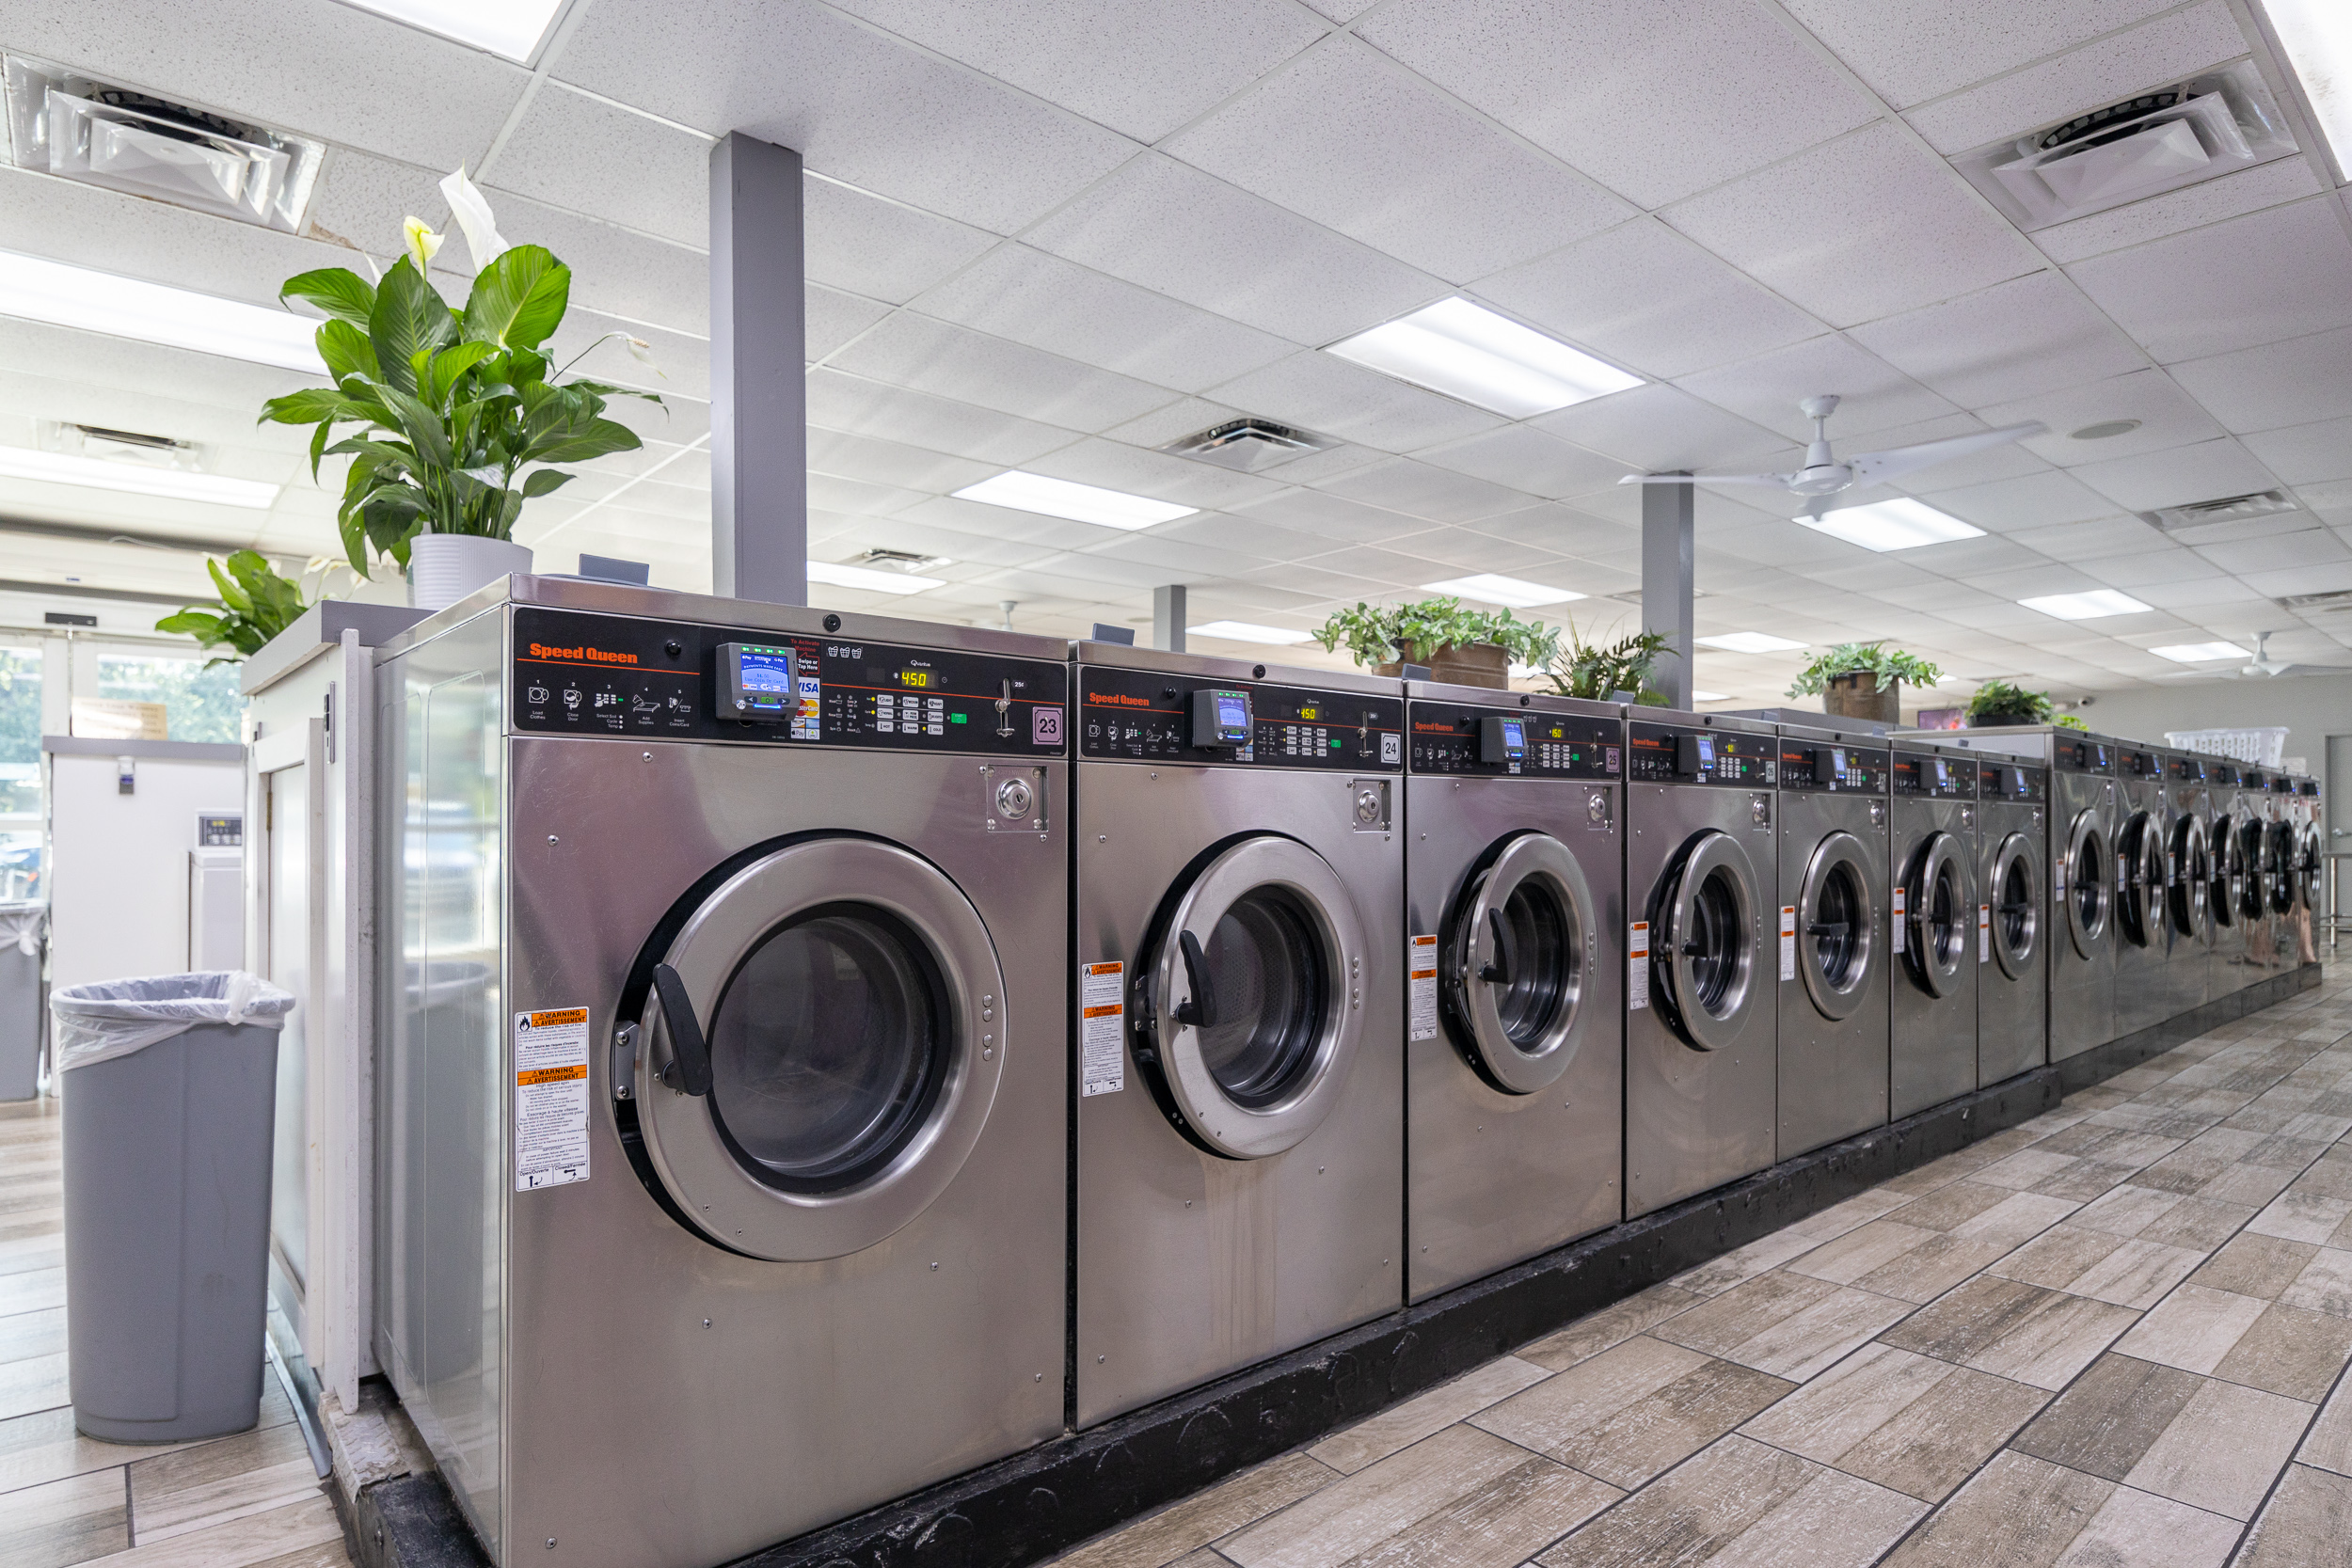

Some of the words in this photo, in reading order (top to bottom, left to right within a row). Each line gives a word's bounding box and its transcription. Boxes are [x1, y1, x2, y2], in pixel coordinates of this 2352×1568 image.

[530, 643, 583, 659] Speed
[586, 648, 638, 663] Queen
[902, 672, 926, 686] 450
[1089, 692, 1119, 704] Speed
[1120, 695, 1149, 706] Queen
[1039, 718, 1057, 733] 23
[1415, 722, 1434, 731] Speed
[1435, 723, 1453, 731] Queen
[1386, 742, 1396, 754] 24
[1609, 755, 1616, 765] 25
[545, 1010, 580, 1019] WARNING
[541, 1017, 585, 1025] AVERTISSEMENT
[538, 1067, 573, 1075] WARNING
[534, 1073, 579, 1083] AVERTISSEMENT
